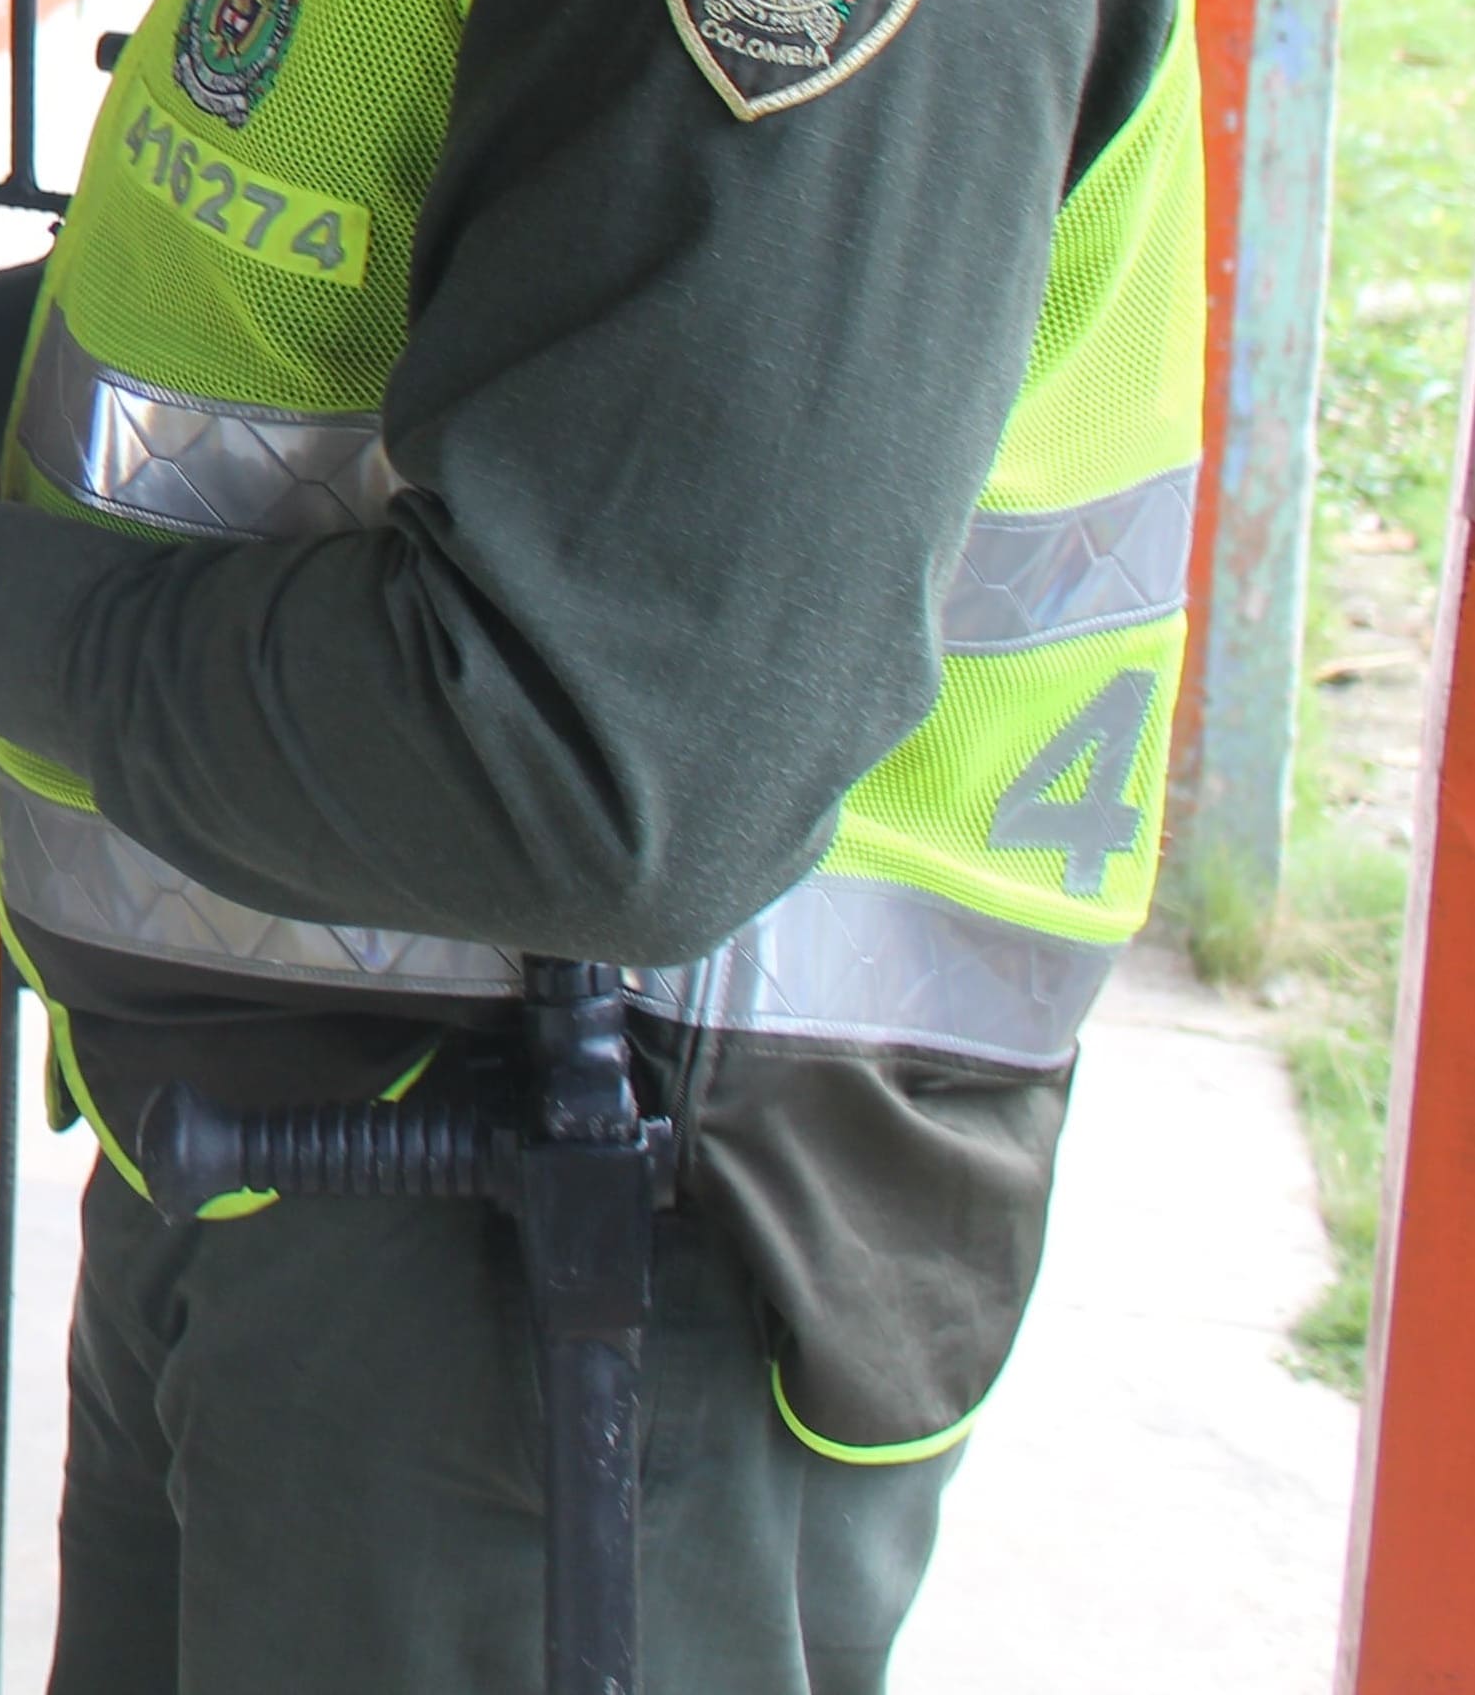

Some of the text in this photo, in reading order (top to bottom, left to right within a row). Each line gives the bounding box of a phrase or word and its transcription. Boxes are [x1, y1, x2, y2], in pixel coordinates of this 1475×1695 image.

[699, 17, 832, 68] COLOMBIA
[125, 106, 347, 270] 416274
[988, 667, 1158, 898] 4
